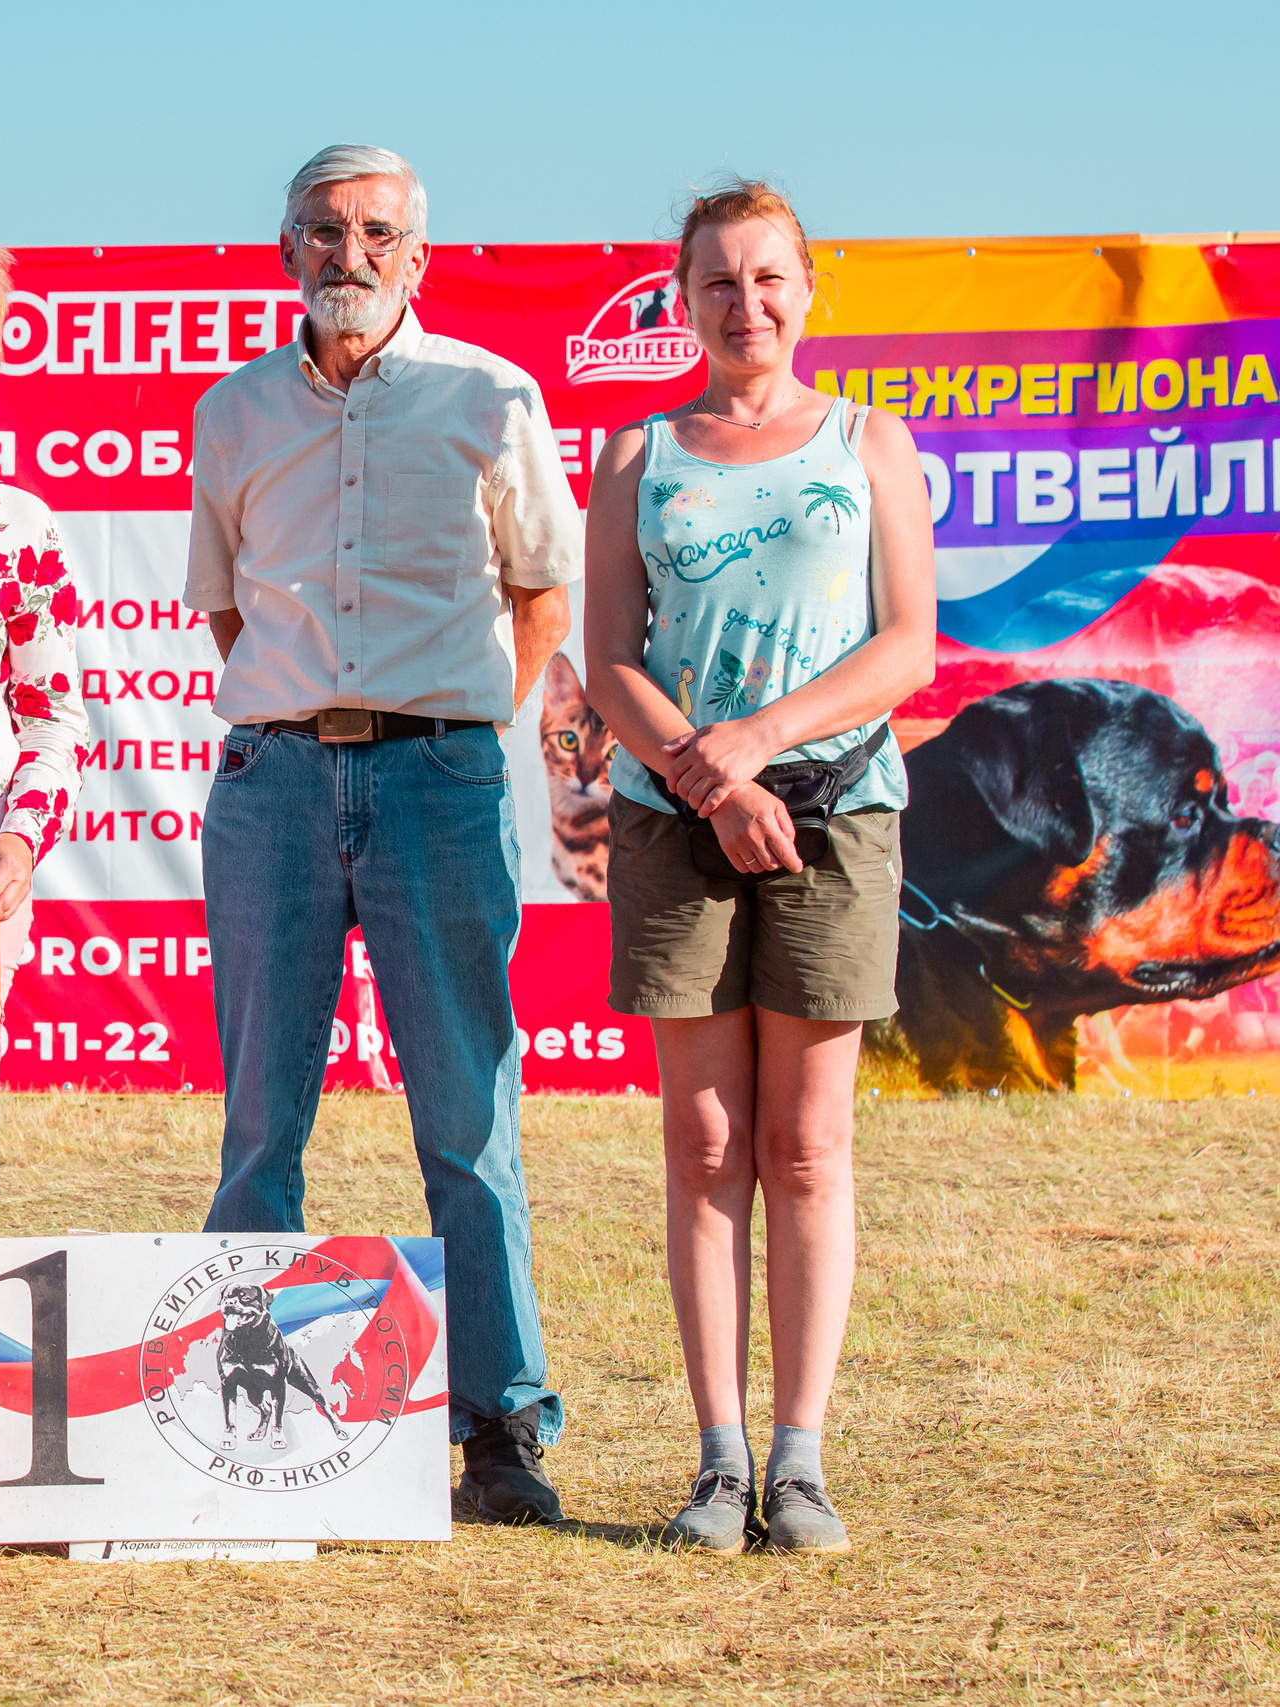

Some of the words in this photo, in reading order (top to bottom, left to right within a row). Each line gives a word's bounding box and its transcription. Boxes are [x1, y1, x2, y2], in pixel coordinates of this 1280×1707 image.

[566, 334, 702, 367] PROFIFEED
[814, 354, 1280, 417] МЕЖРЕГИОНА
[36, 430, 193, 478] СОБ
[645, 517, 792, 583] Havana
[721, 607, 777, 638] good
[775, 626, 812, 670] time
[81, 668, 216, 707] ДХОД
[145, 1254, 243, 1425] РОТВЕЙЛЕР
[265, 1250, 354, 1288] КЛУБ
[361, 1295, 405, 1426] РОССИИ
[208, 1450, 351, 1487] РКФ-НКПР
[120, 1540, 161, 1551] Корма
[163, 1541, 205, 1550] нового
[207, 1540, 270, 1550] поколения
